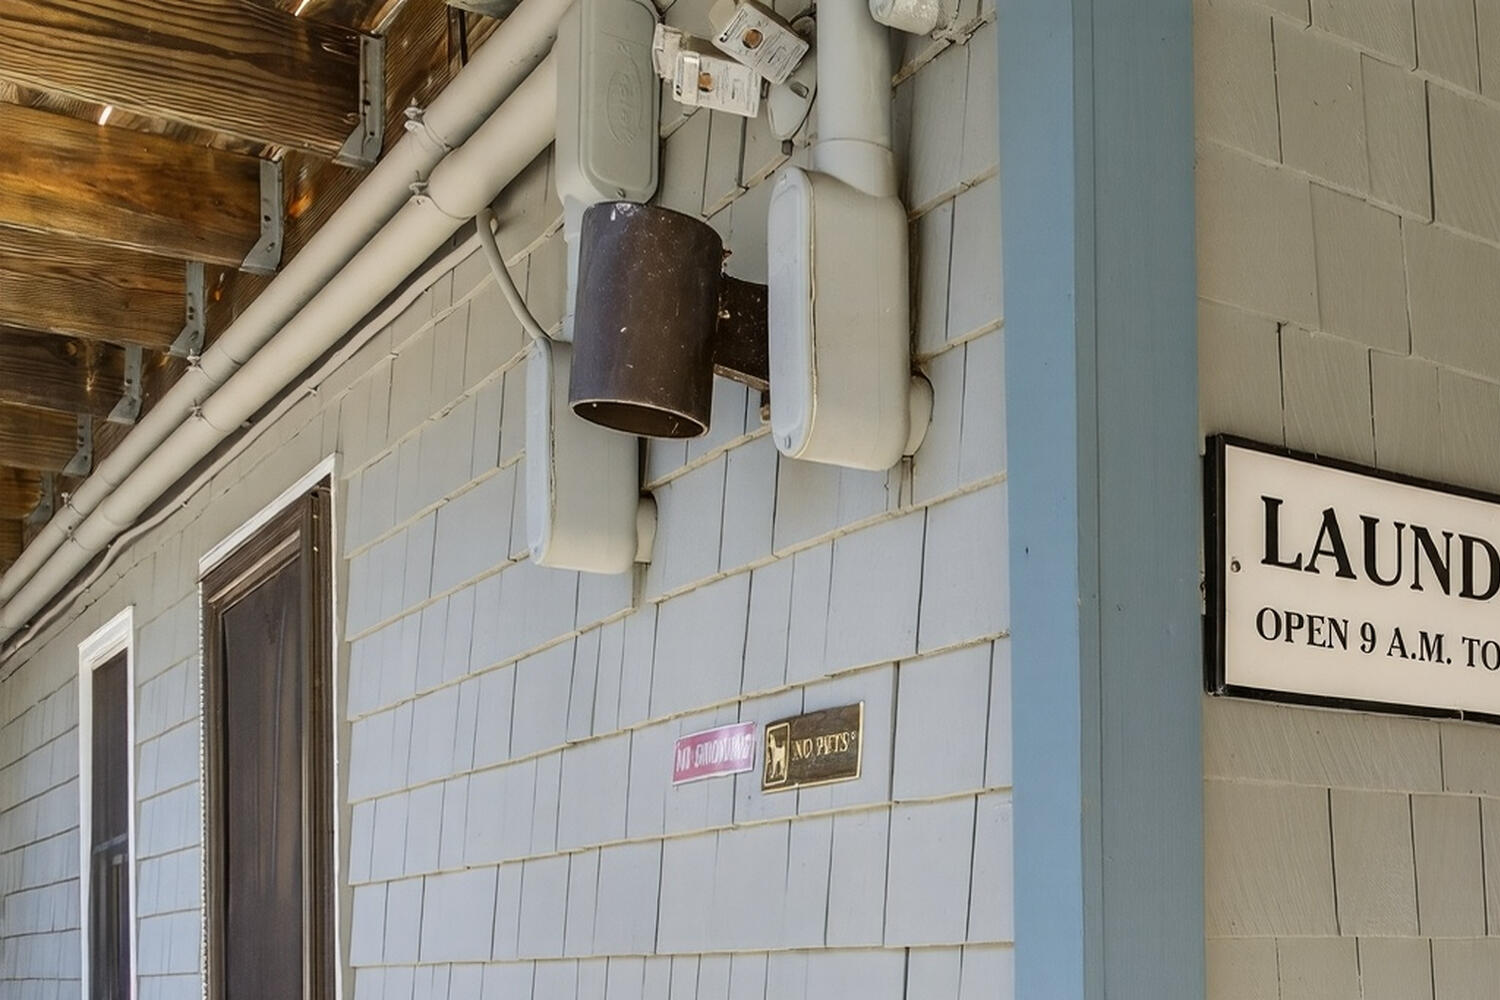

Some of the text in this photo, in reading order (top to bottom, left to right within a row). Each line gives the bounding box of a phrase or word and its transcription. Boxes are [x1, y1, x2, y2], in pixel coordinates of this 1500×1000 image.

[1256, 606, 1349, 651] OPEN
[1360, 621, 1377, 654] 9
[1386, 626, 1452, 665] A.M.
[1461, 636, 1500, 671] TO
[791, 738, 813, 761] NO
